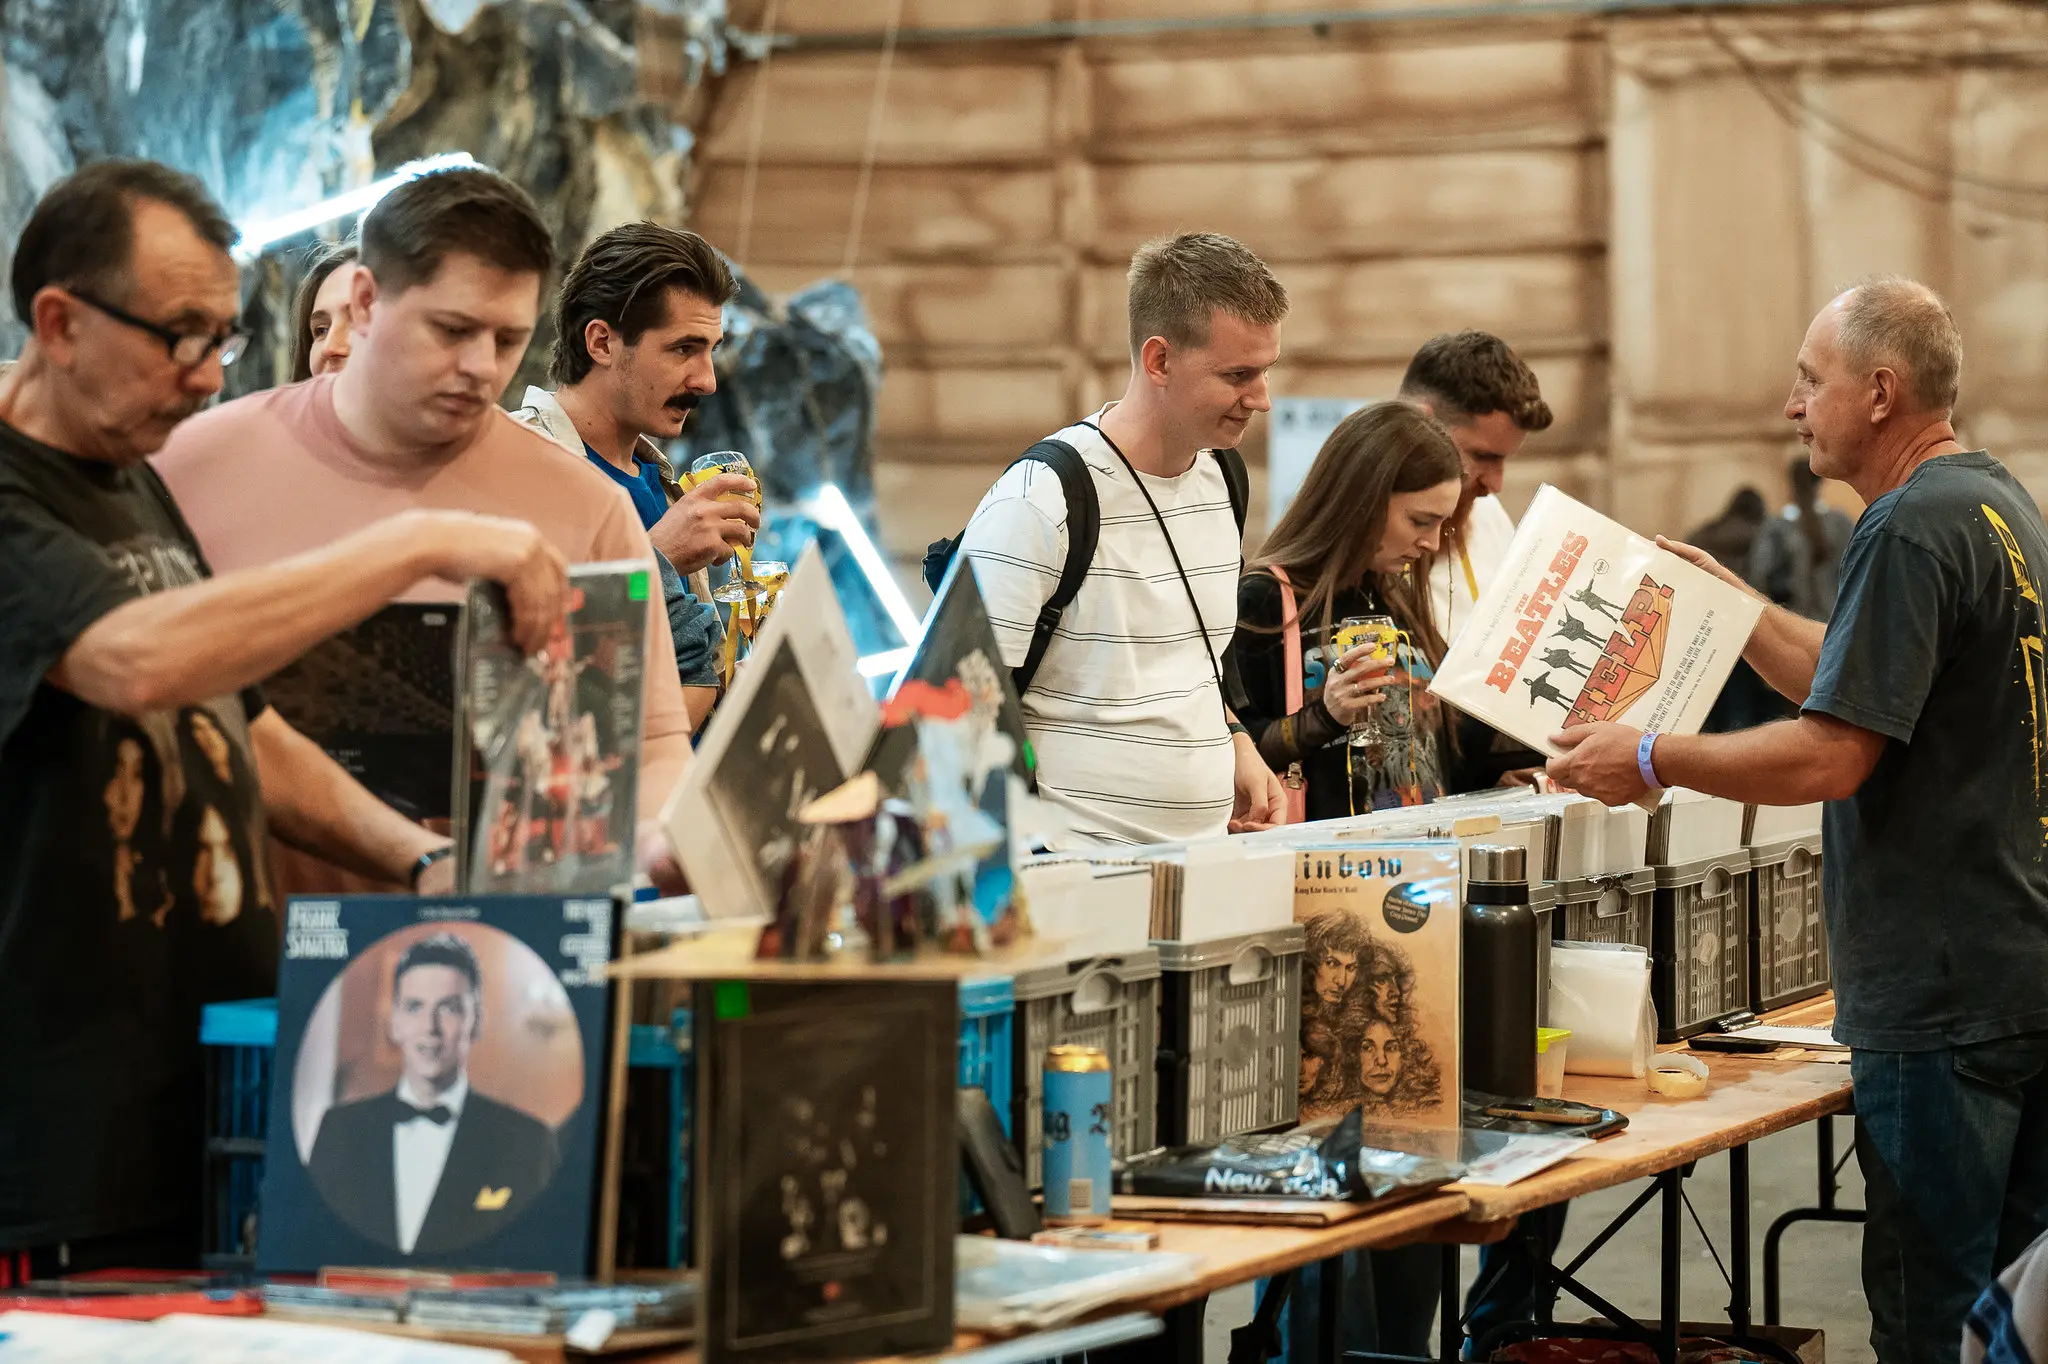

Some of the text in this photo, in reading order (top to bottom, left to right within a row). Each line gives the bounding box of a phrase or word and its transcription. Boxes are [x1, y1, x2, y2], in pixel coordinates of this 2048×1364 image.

[1484, 530, 1589, 694] BEATLES
[1514, 593, 1530, 614] THE
[1705, 608, 1715, 619] YOU
[1560, 573, 1675, 730] HELP!
[1302, 853, 1403, 880] inbow
[1205, 1166, 1274, 1195] New
